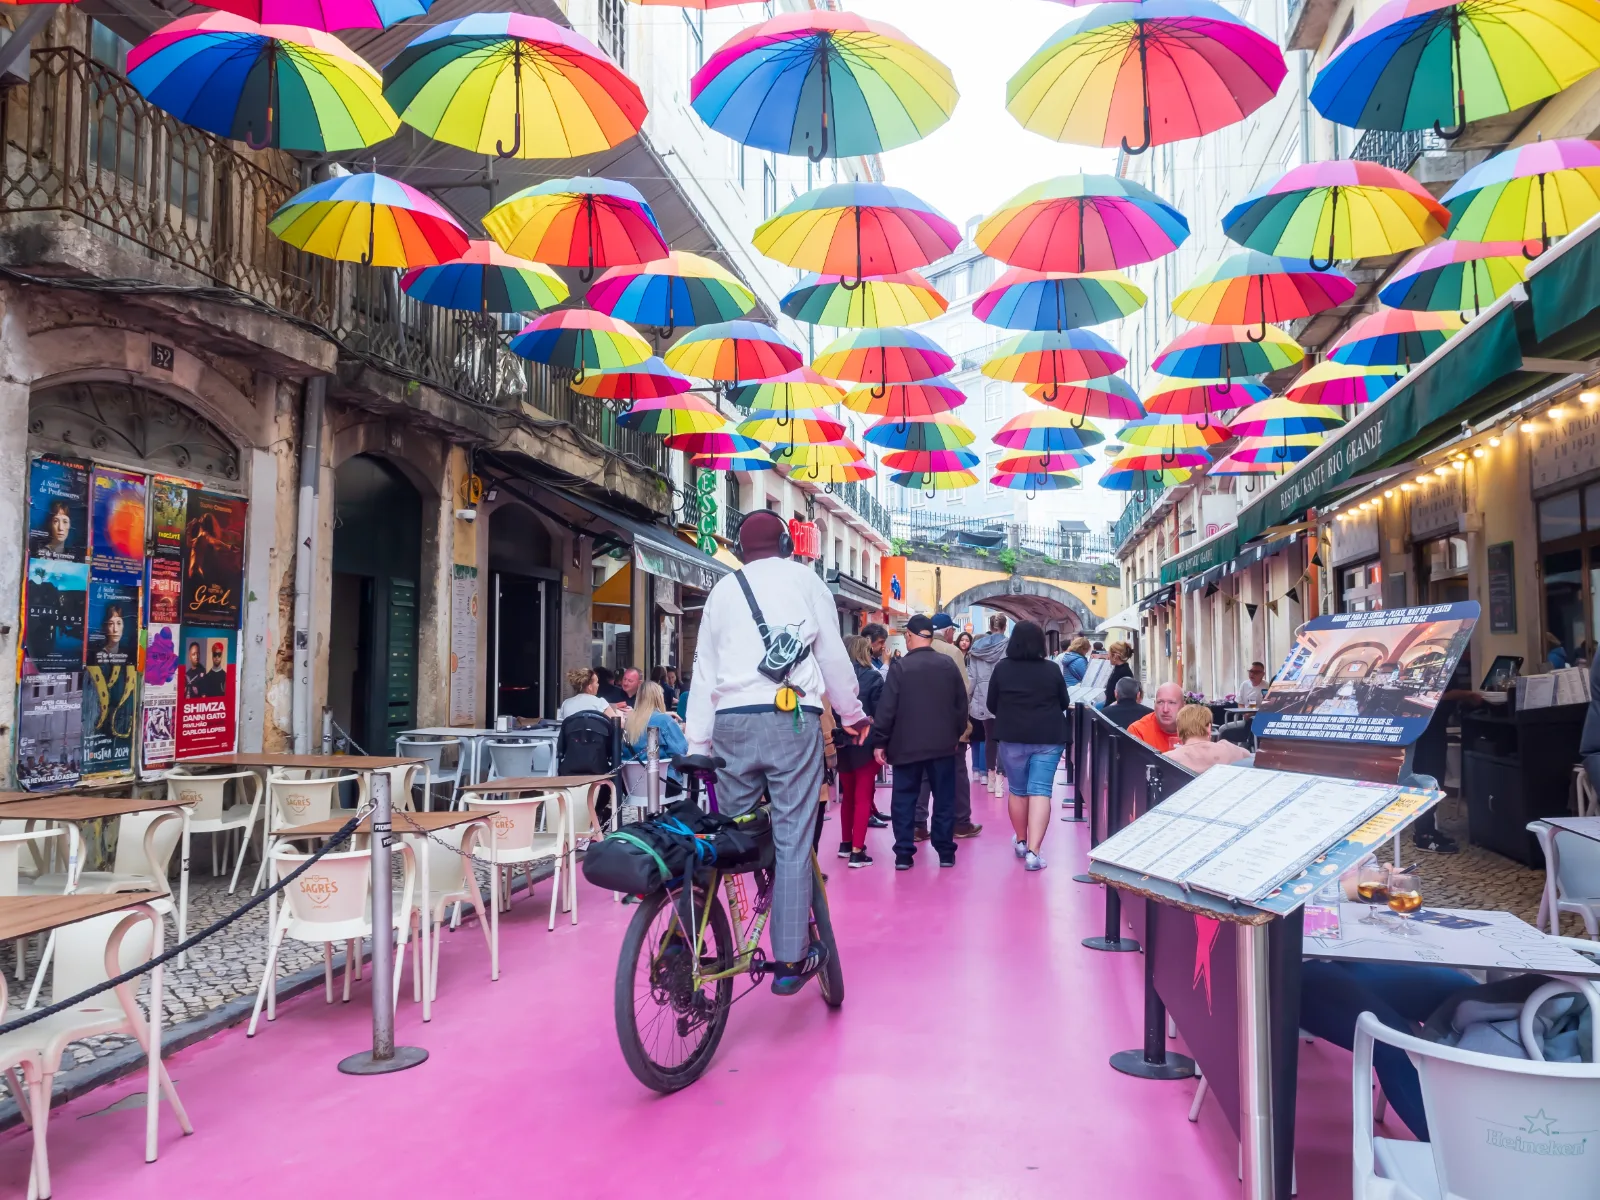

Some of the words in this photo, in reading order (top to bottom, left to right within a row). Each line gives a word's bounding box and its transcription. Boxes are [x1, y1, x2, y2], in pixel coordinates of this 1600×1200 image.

[156, 346, 171, 367] 52
[1280, 463, 1325, 511] RESTAURANTE
[1327, 450, 1344, 478] RIO
[1346, 420, 1384, 465] GRANDE
[190, 584, 230, 610] Gal
[1407, 608, 1420, 616] WAIT
[1432, 604, 1453, 613] SEATED
[1411, 614, 1429, 622] PLACE
[184, 701, 226, 714] SHIMZA
[183, 714, 205, 722] DANNI
[206, 712, 226, 720] GATO
[182, 721, 208, 729] PAVILHÃO
[114, 747, 129, 758] 2024
[30, 775, 62, 783] REVOLUÇÃO
[495, 820, 515, 829] GRES
[300, 881, 338, 893] SAGRES
[1486, 1128, 1587, 1156] Heineken
